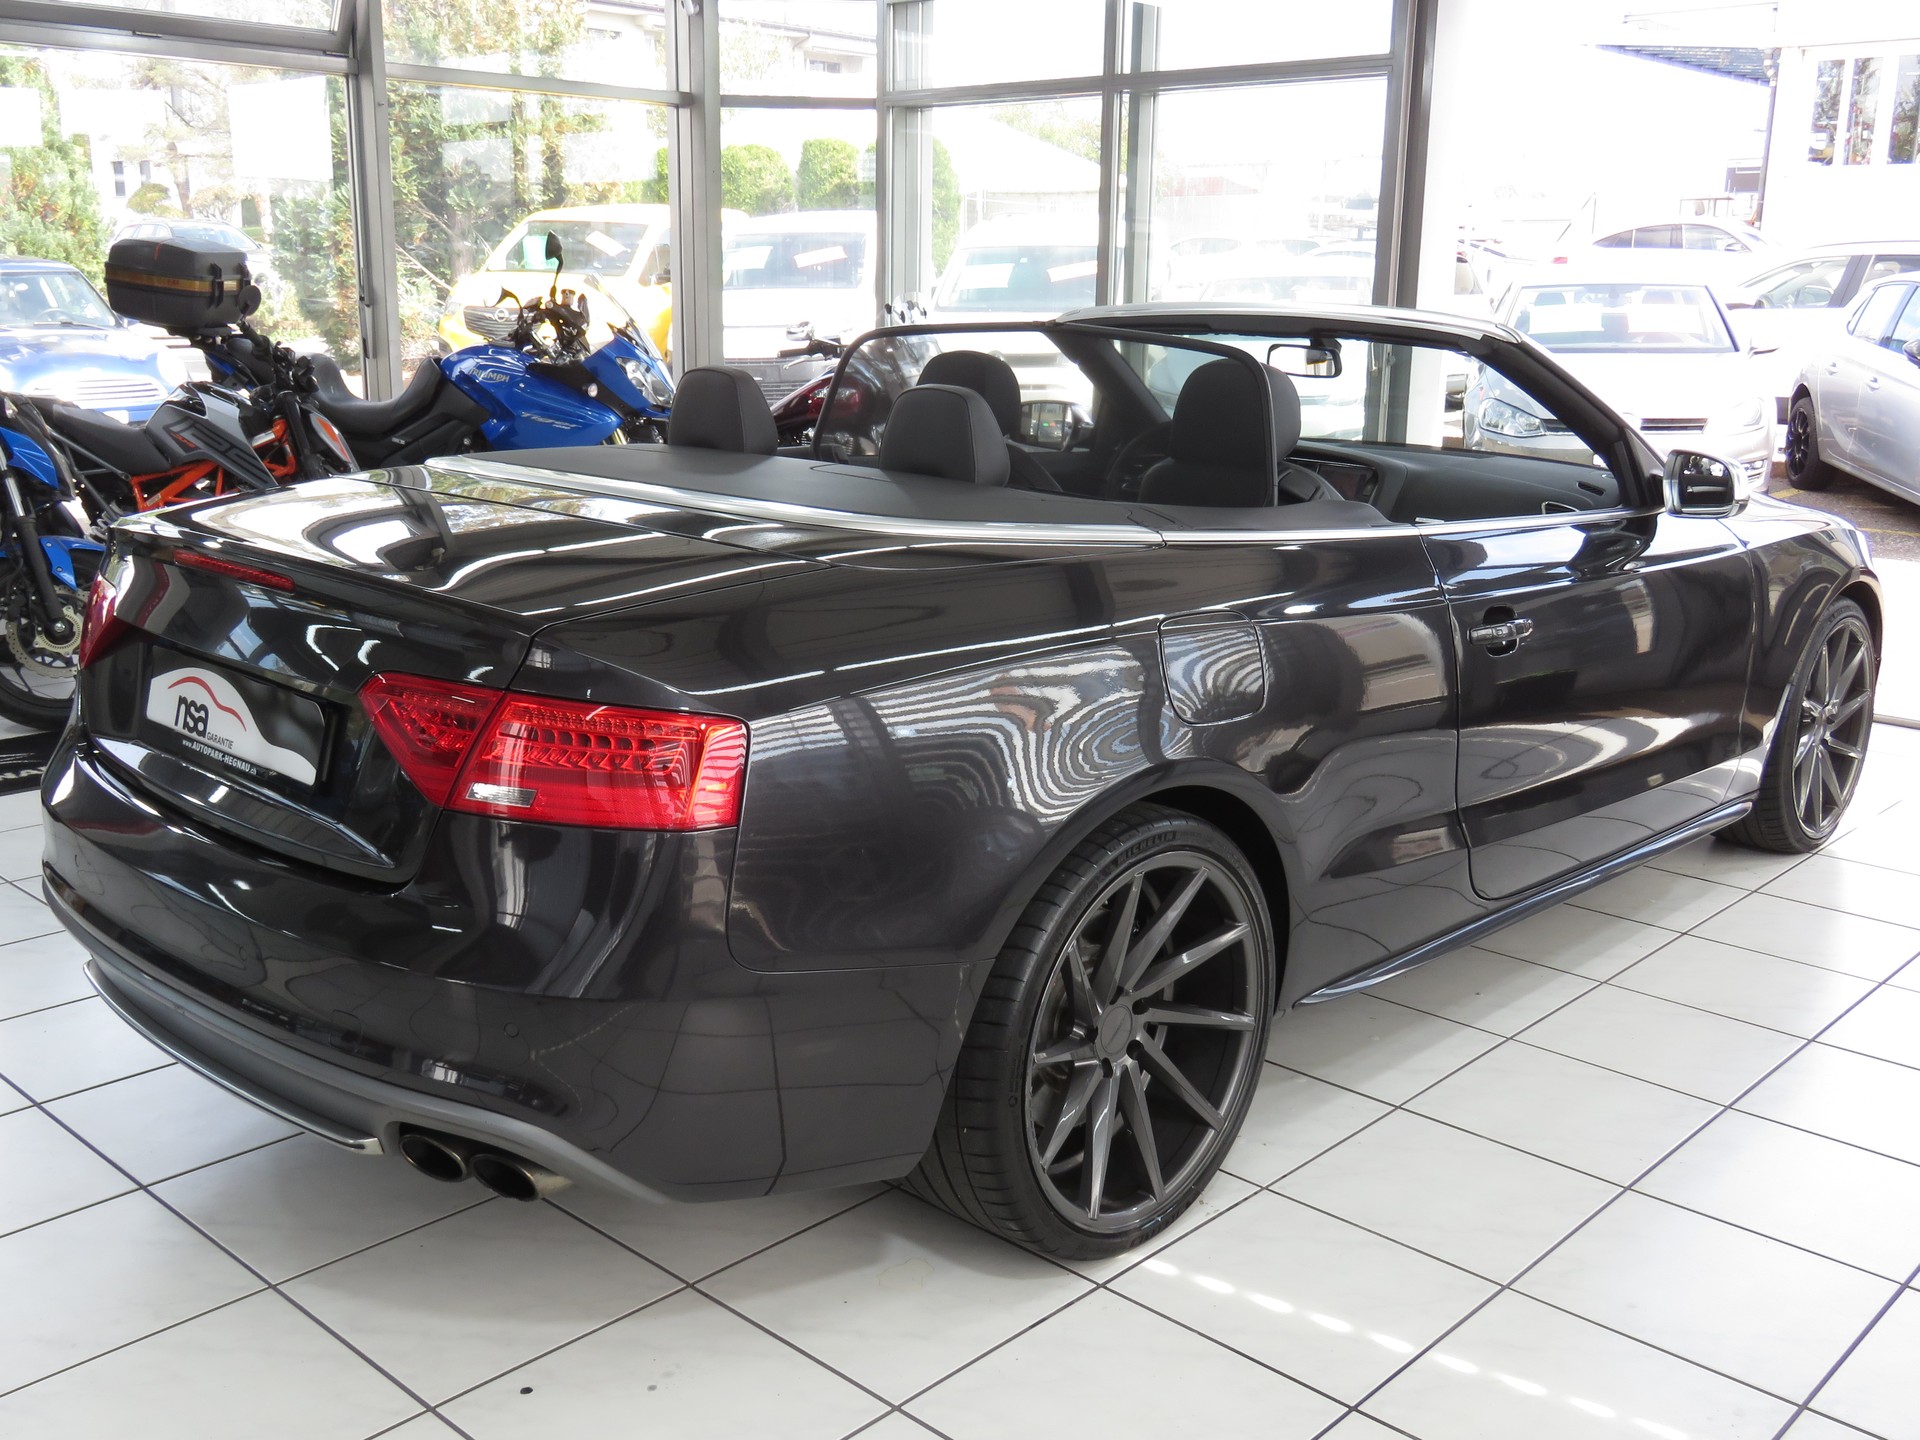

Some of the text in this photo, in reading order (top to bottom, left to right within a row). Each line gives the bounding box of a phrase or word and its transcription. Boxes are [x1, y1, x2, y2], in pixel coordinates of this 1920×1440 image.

[468, 368, 510, 383] TRIUMPH
[174, 695, 209, 738] nsa
[207, 732, 234, 749] GARANTIE
[1116, 831, 1174, 864] MICHELIN
